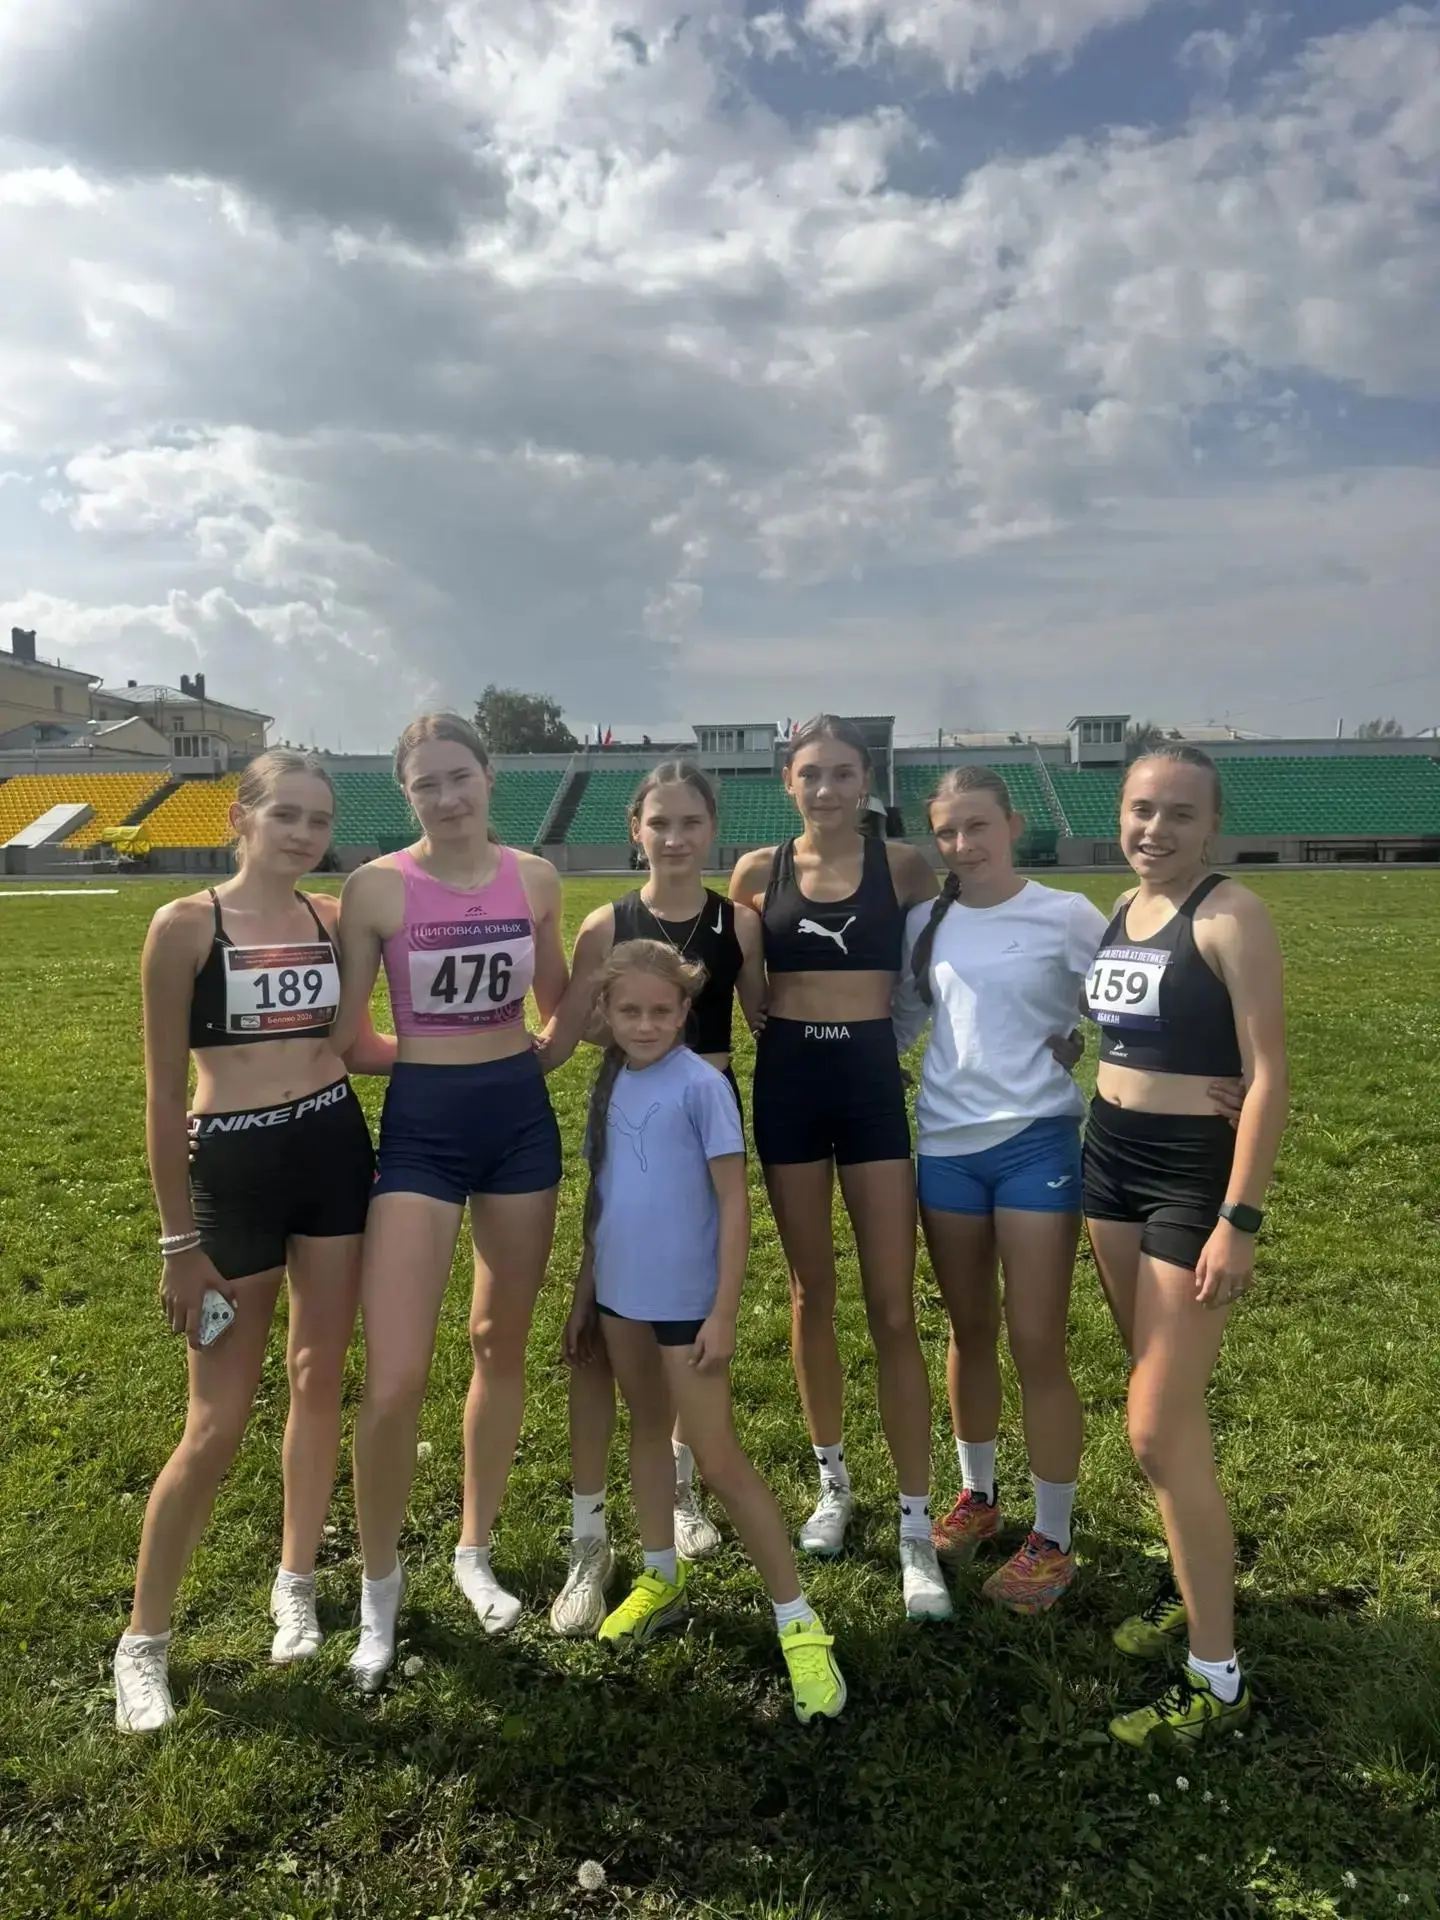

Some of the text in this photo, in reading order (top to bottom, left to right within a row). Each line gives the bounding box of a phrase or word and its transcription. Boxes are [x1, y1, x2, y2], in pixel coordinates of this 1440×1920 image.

[416, 923, 522, 937] ШИПОВКА ЮНЫХ
[253, 969, 323, 1009] 189
[430, 952, 513, 1004] 476
[1090, 968, 1149, 1004] 159
[804, 1025, 850, 1040] PUMA
[206, 1083, 348, 1133] NIKE PRO
